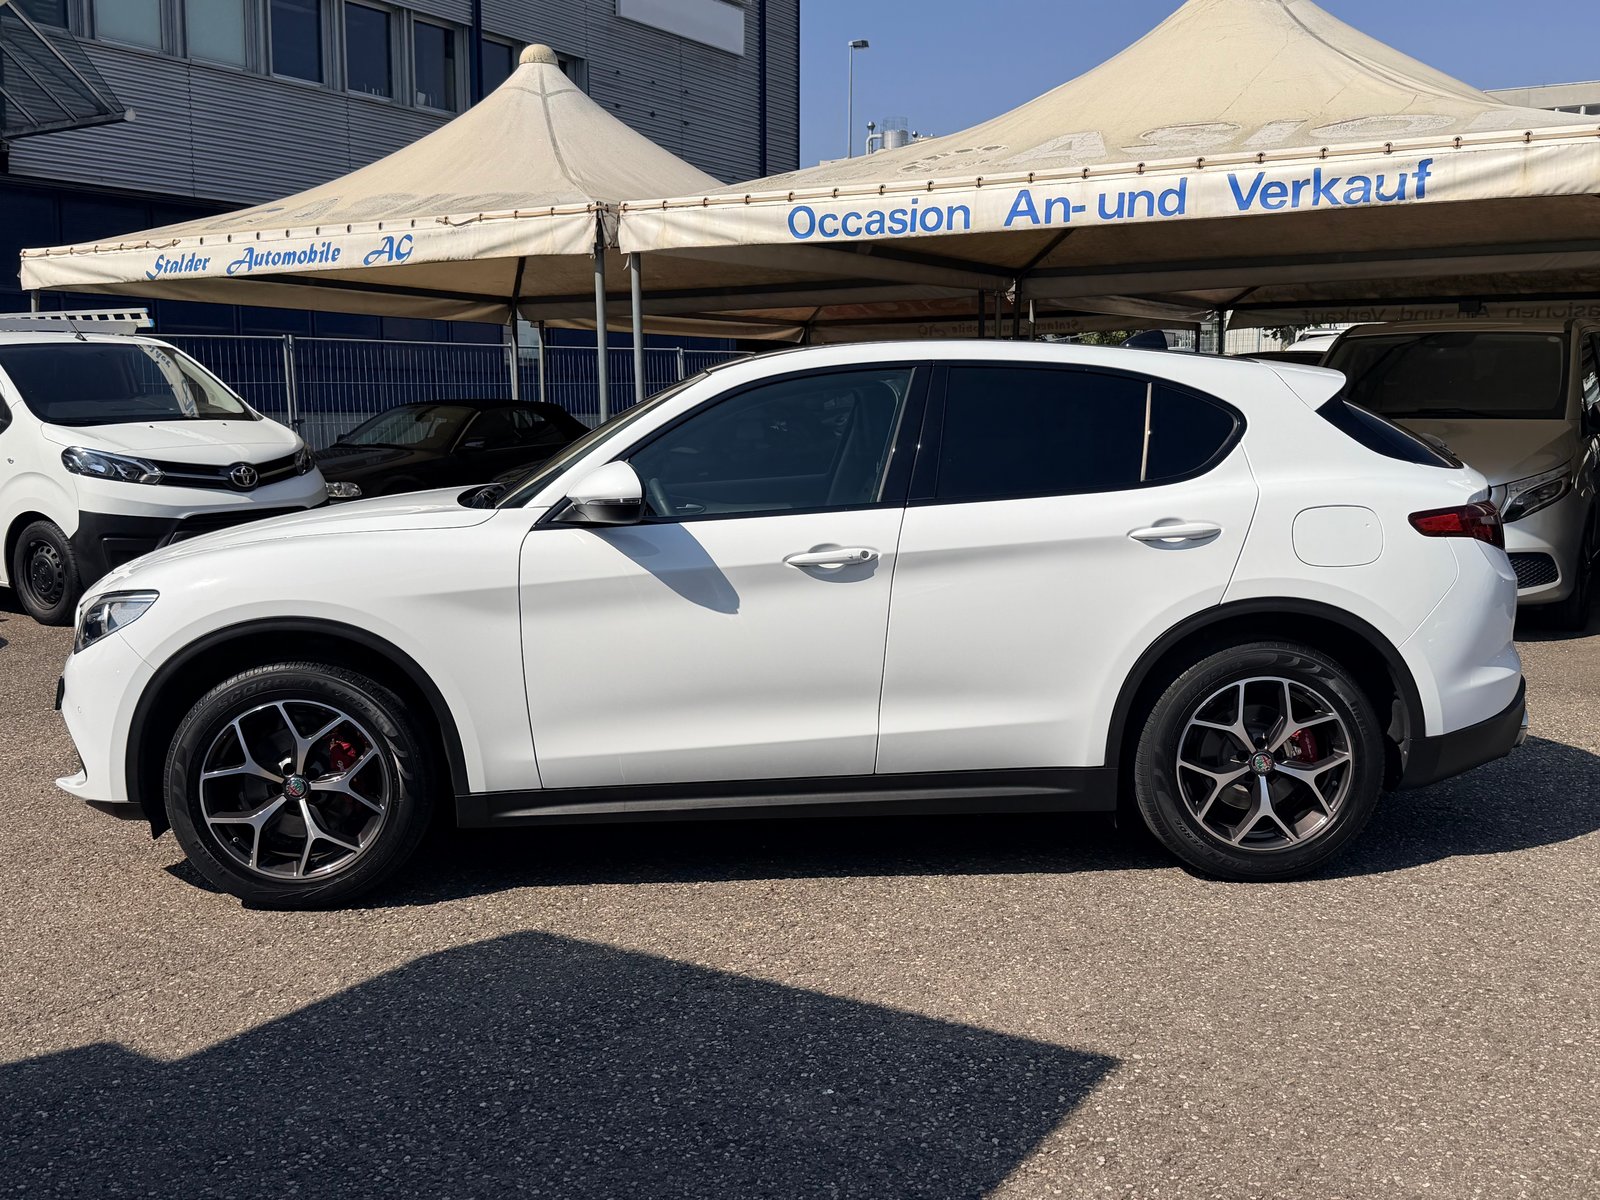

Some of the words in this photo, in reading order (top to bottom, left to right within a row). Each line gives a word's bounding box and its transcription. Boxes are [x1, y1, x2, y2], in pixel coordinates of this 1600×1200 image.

[786, 199, 972, 241] Occasion
[1003, 189, 1088, 229] An-
[1096, 177, 1188, 222] und
[1227, 159, 1434, 213] Verkauf
[145, 254, 211, 281] Stalder
[225, 242, 342, 276] Automobile
[362, 233, 415, 266] AG
